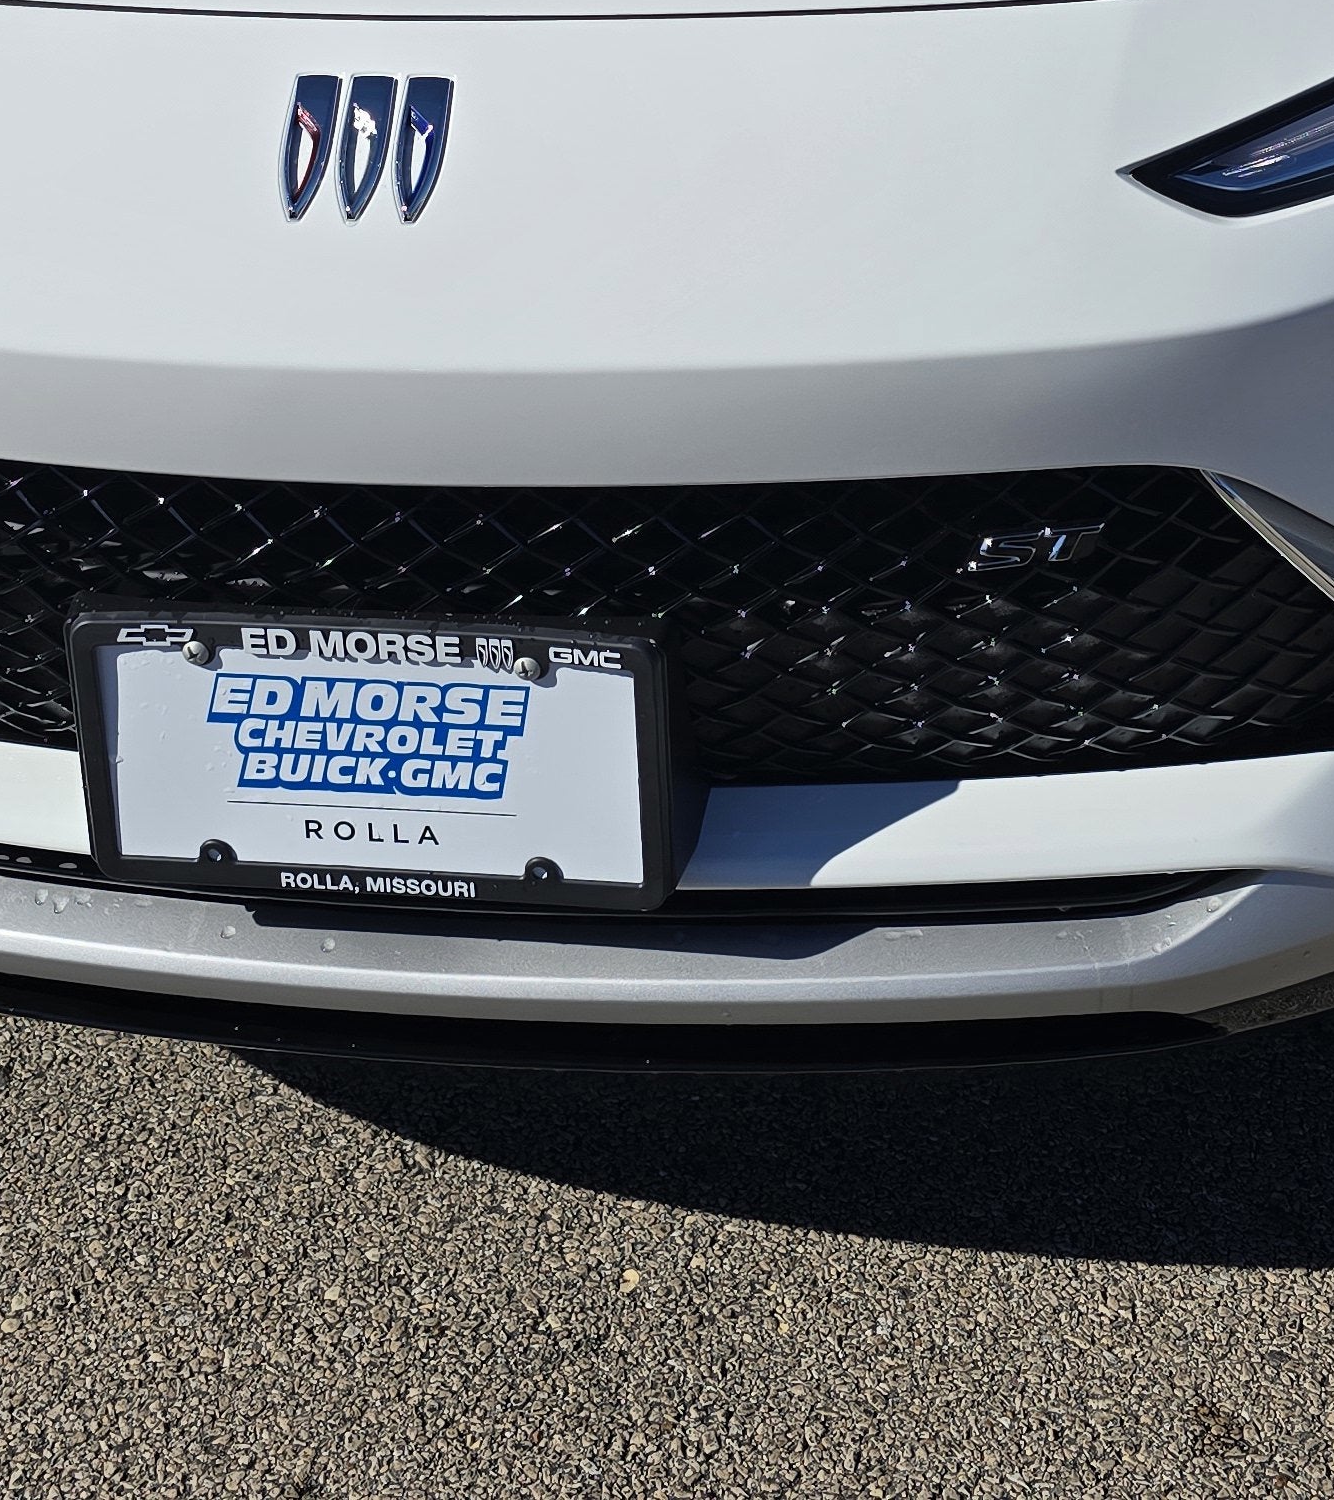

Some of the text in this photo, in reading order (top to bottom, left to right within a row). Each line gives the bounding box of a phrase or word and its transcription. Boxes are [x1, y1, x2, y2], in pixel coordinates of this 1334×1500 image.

[968, 522, 1105, 572] ST
[240, 627, 463, 664] ED MORSE
[548, 646, 622, 670] GMC
[211, 676, 526, 727] ED MORSE
[237, 717, 504, 759] CHEVROLET
[304, 819, 440, 846] ROLLA
[280, 871, 476, 898] ROLLA, MISSOURI
